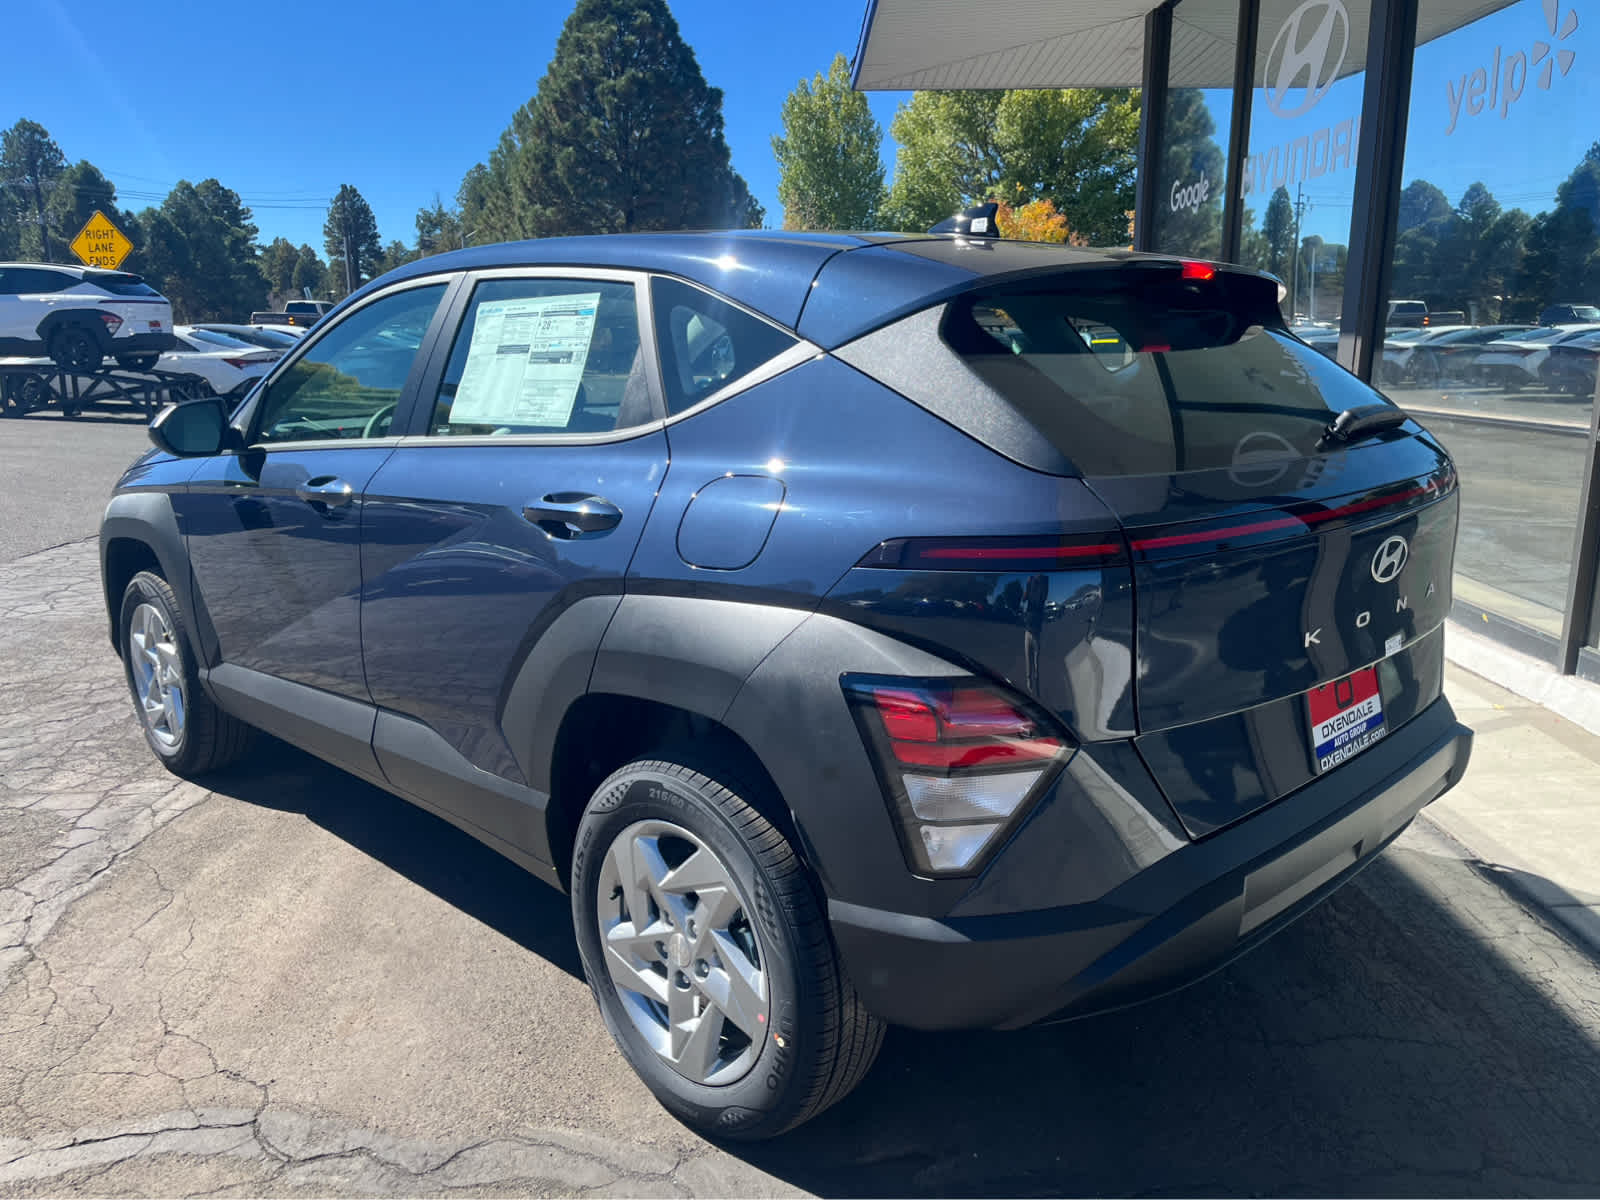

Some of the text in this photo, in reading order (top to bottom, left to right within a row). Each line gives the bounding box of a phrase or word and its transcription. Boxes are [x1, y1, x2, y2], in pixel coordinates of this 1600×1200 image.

[1445, 45, 1527, 136] yelp
[1170, 170, 1209, 215] Google
[85, 229, 115, 240] RIGHT
[88, 242, 115, 253] LANE
[89, 255, 116, 266] ENDS
[1304, 582, 1436, 648] KONA
[1321, 701, 1374, 738] OXENDALE
[1334, 722, 1368, 748] AUTO GROUP
[1320, 727, 1386, 772] OXENDALE.com
